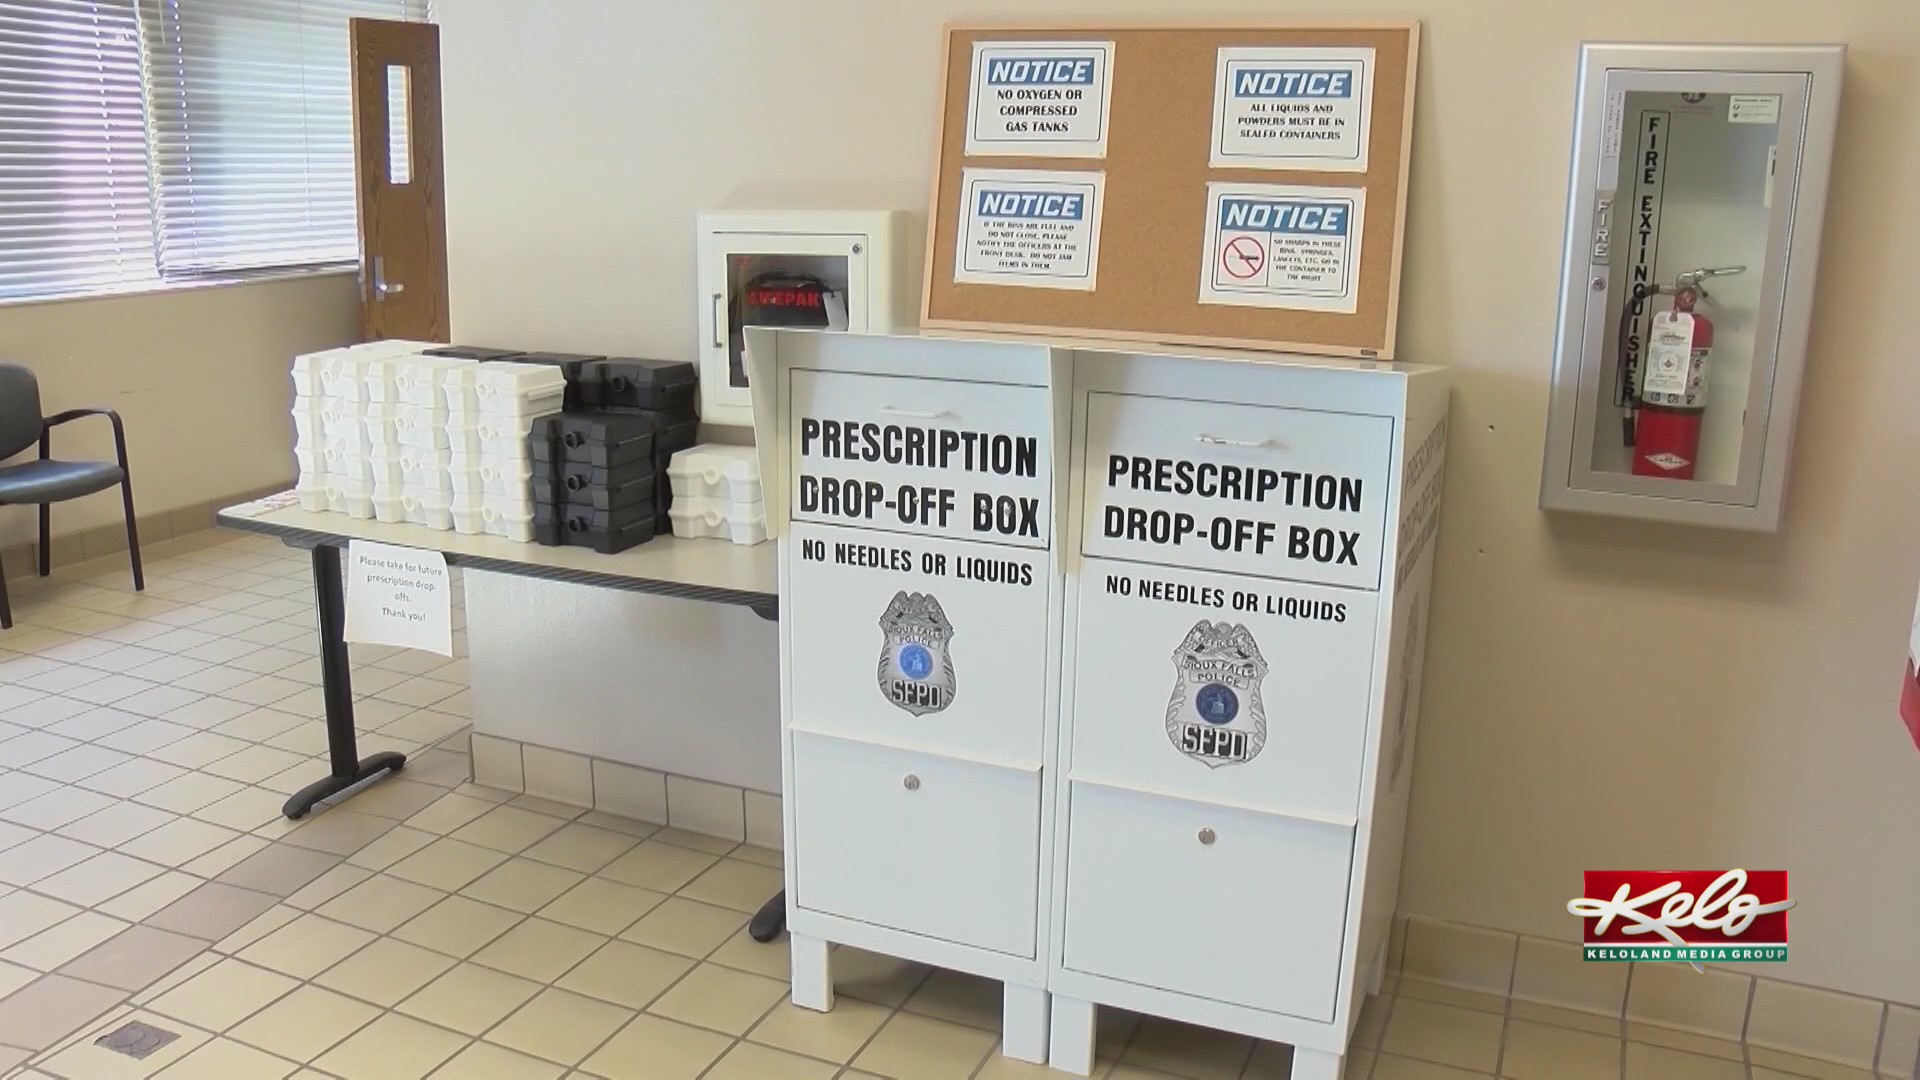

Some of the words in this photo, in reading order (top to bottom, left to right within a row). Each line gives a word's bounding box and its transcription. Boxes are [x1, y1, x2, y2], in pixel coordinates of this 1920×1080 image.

[991, 61, 1091, 82] NOTICE
[997, 90, 1013, 100] NO
[1017, 90, 1062, 100] OXYGEN
[1066, 90, 1082, 100] OR
[1239, 73, 1348, 95] NOTICE
[1000, 106, 1078, 116] COMPRESSED
[1238, 117, 1285, 126] POWDERS
[1288, 118, 1315, 126] MUST
[1334, 118, 1345, 126] IN
[1006, 122, 1028, 132] GAS
[1032, 122, 1069, 132] TANKS
[1279, 130, 1341, 140] CONTAINERS
[1643, 117, 1661, 185] FIRE
[982, 193, 1080, 216] NOTICE
[1225, 203, 1344, 230] NOTICE
[1594, 199, 1612, 257] FIRE
[801, 417, 1038, 478] PRESCRIPTION
[1108, 454, 1363, 512] PRESCRIPTION
[800, 475, 956, 527] DROP-OFF
[973, 492, 1040, 538] BOX
[1104, 505, 1276, 555] DROP-OFF
[1288, 525, 1360, 566] BOX
[360, 555, 384, 567] Please
[387, 561, 403, 570] take
[405, 562, 416, 572] for
[418, 564, 443, 576] future
[802, 539, 825, 562] NO
[835, 543, 912, 572] NEEDLES
[922, 552, 946, 576] OR
[956, 557, 1032, 586] LIQUIDS
[367, 574, 414, 587] prescription
[1106, 575, 1131, 596] NO
[1139, 580, 1225, 608] NEEDLES
[1232, 591, 1258, 611] OR
[1266, 596, 1347, 622] LIQUIDS
[382, 607, 407, 619] Thank
[408, 612, 426, 622] you!
[1184, 660, 1218, 670] SIOUX
[1222, 662, 1255, 678] FALLS
[1198, 673, 1241, 688] POLICE
[892, 680, 941, 708] SFPD
[1183, 724, 1248, 759] SFPD
